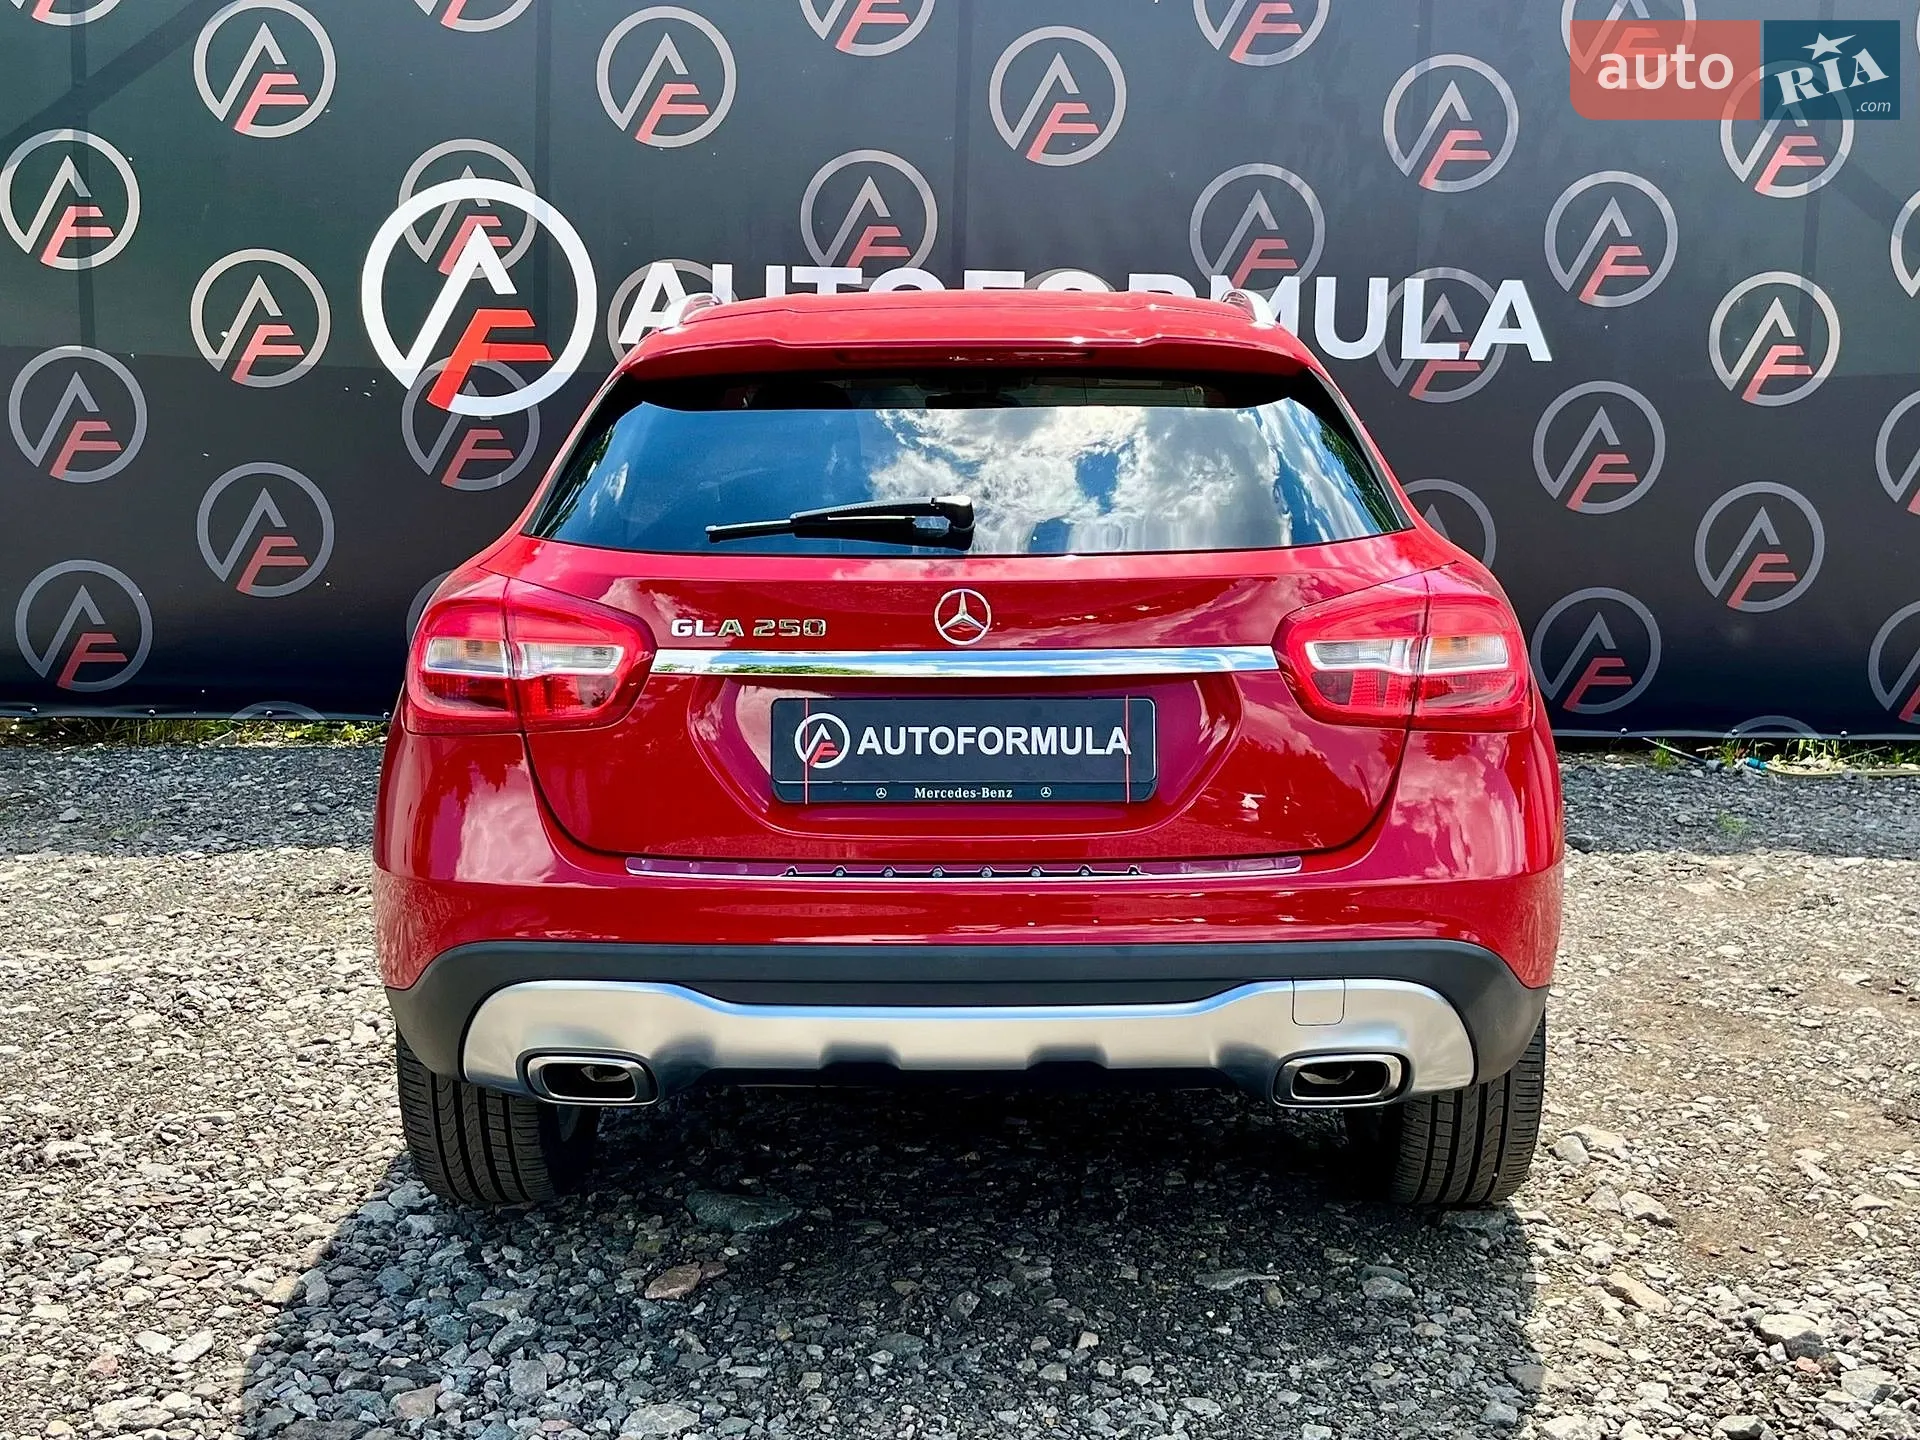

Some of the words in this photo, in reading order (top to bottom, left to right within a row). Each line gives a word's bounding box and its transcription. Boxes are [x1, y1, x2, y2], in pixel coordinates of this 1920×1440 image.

[218, 19, 311, 136] AF
[619, 30, 712, 147] AF
[1008, 49, 1102, 164] AF
[1401, 77, 1494, 191] AF
[23, 152, 117, 269] AF
[1562, 194, 1653, 307] AF
[214, 273, 307, 387] AF
[1726, 294, 1817, 405] AF
[34, 369, 124, 481] AF
[1551, 403, 1641, 514] AF
[220, 485, 311, 596] AF
[1711, 504, 1800, 612] AF
[41, 582, 130, 691] AF
[670, 618, 745, 638] GLA
[752, 618, 828, 638] 250
[1546, 609, 1636, 713] AF
[856, 725, 1132, 756] AUTOFORMULA
[914, 786, 1013, 800] Mercedes-Benz
